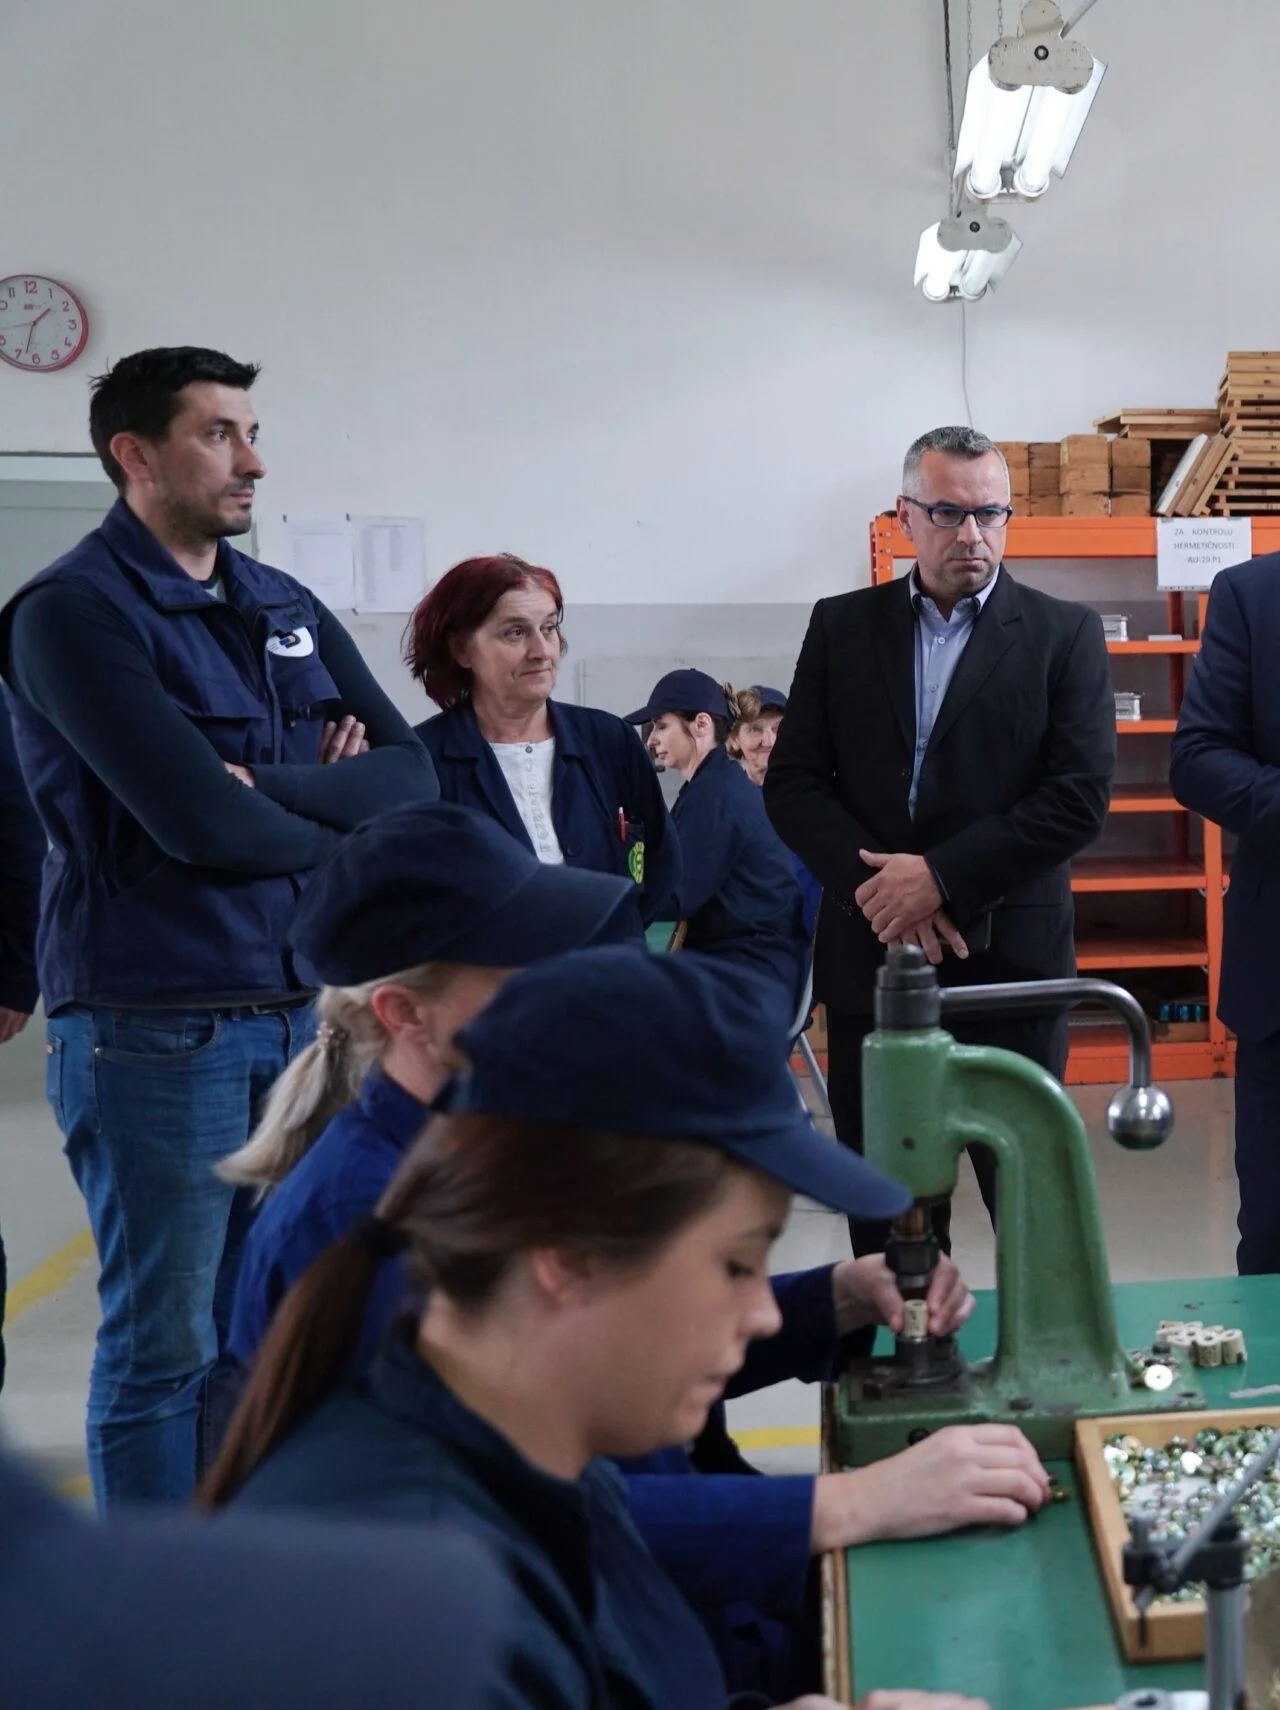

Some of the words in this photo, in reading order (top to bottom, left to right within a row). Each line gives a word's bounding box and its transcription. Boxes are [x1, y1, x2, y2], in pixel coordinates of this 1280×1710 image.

[8, 287, 15, 298] 11
[24, 281, 37, 294] 12
[48, 288, 53, 298] 1
[62, 301, 70, 312] 2
[68, 319, 77, 330] 3
[64, 337, 72, 347] 4
[15, 349, 22, 359] 7
[32, 353, 40, 364] 6
[51, 349, 60, 360] 5
[1174, 528, 1184, 536] ZA
[1192, 528, 1233, 536] KONTROLU
[1174, 541, 1235, 550] HERMETIČNOSTI
